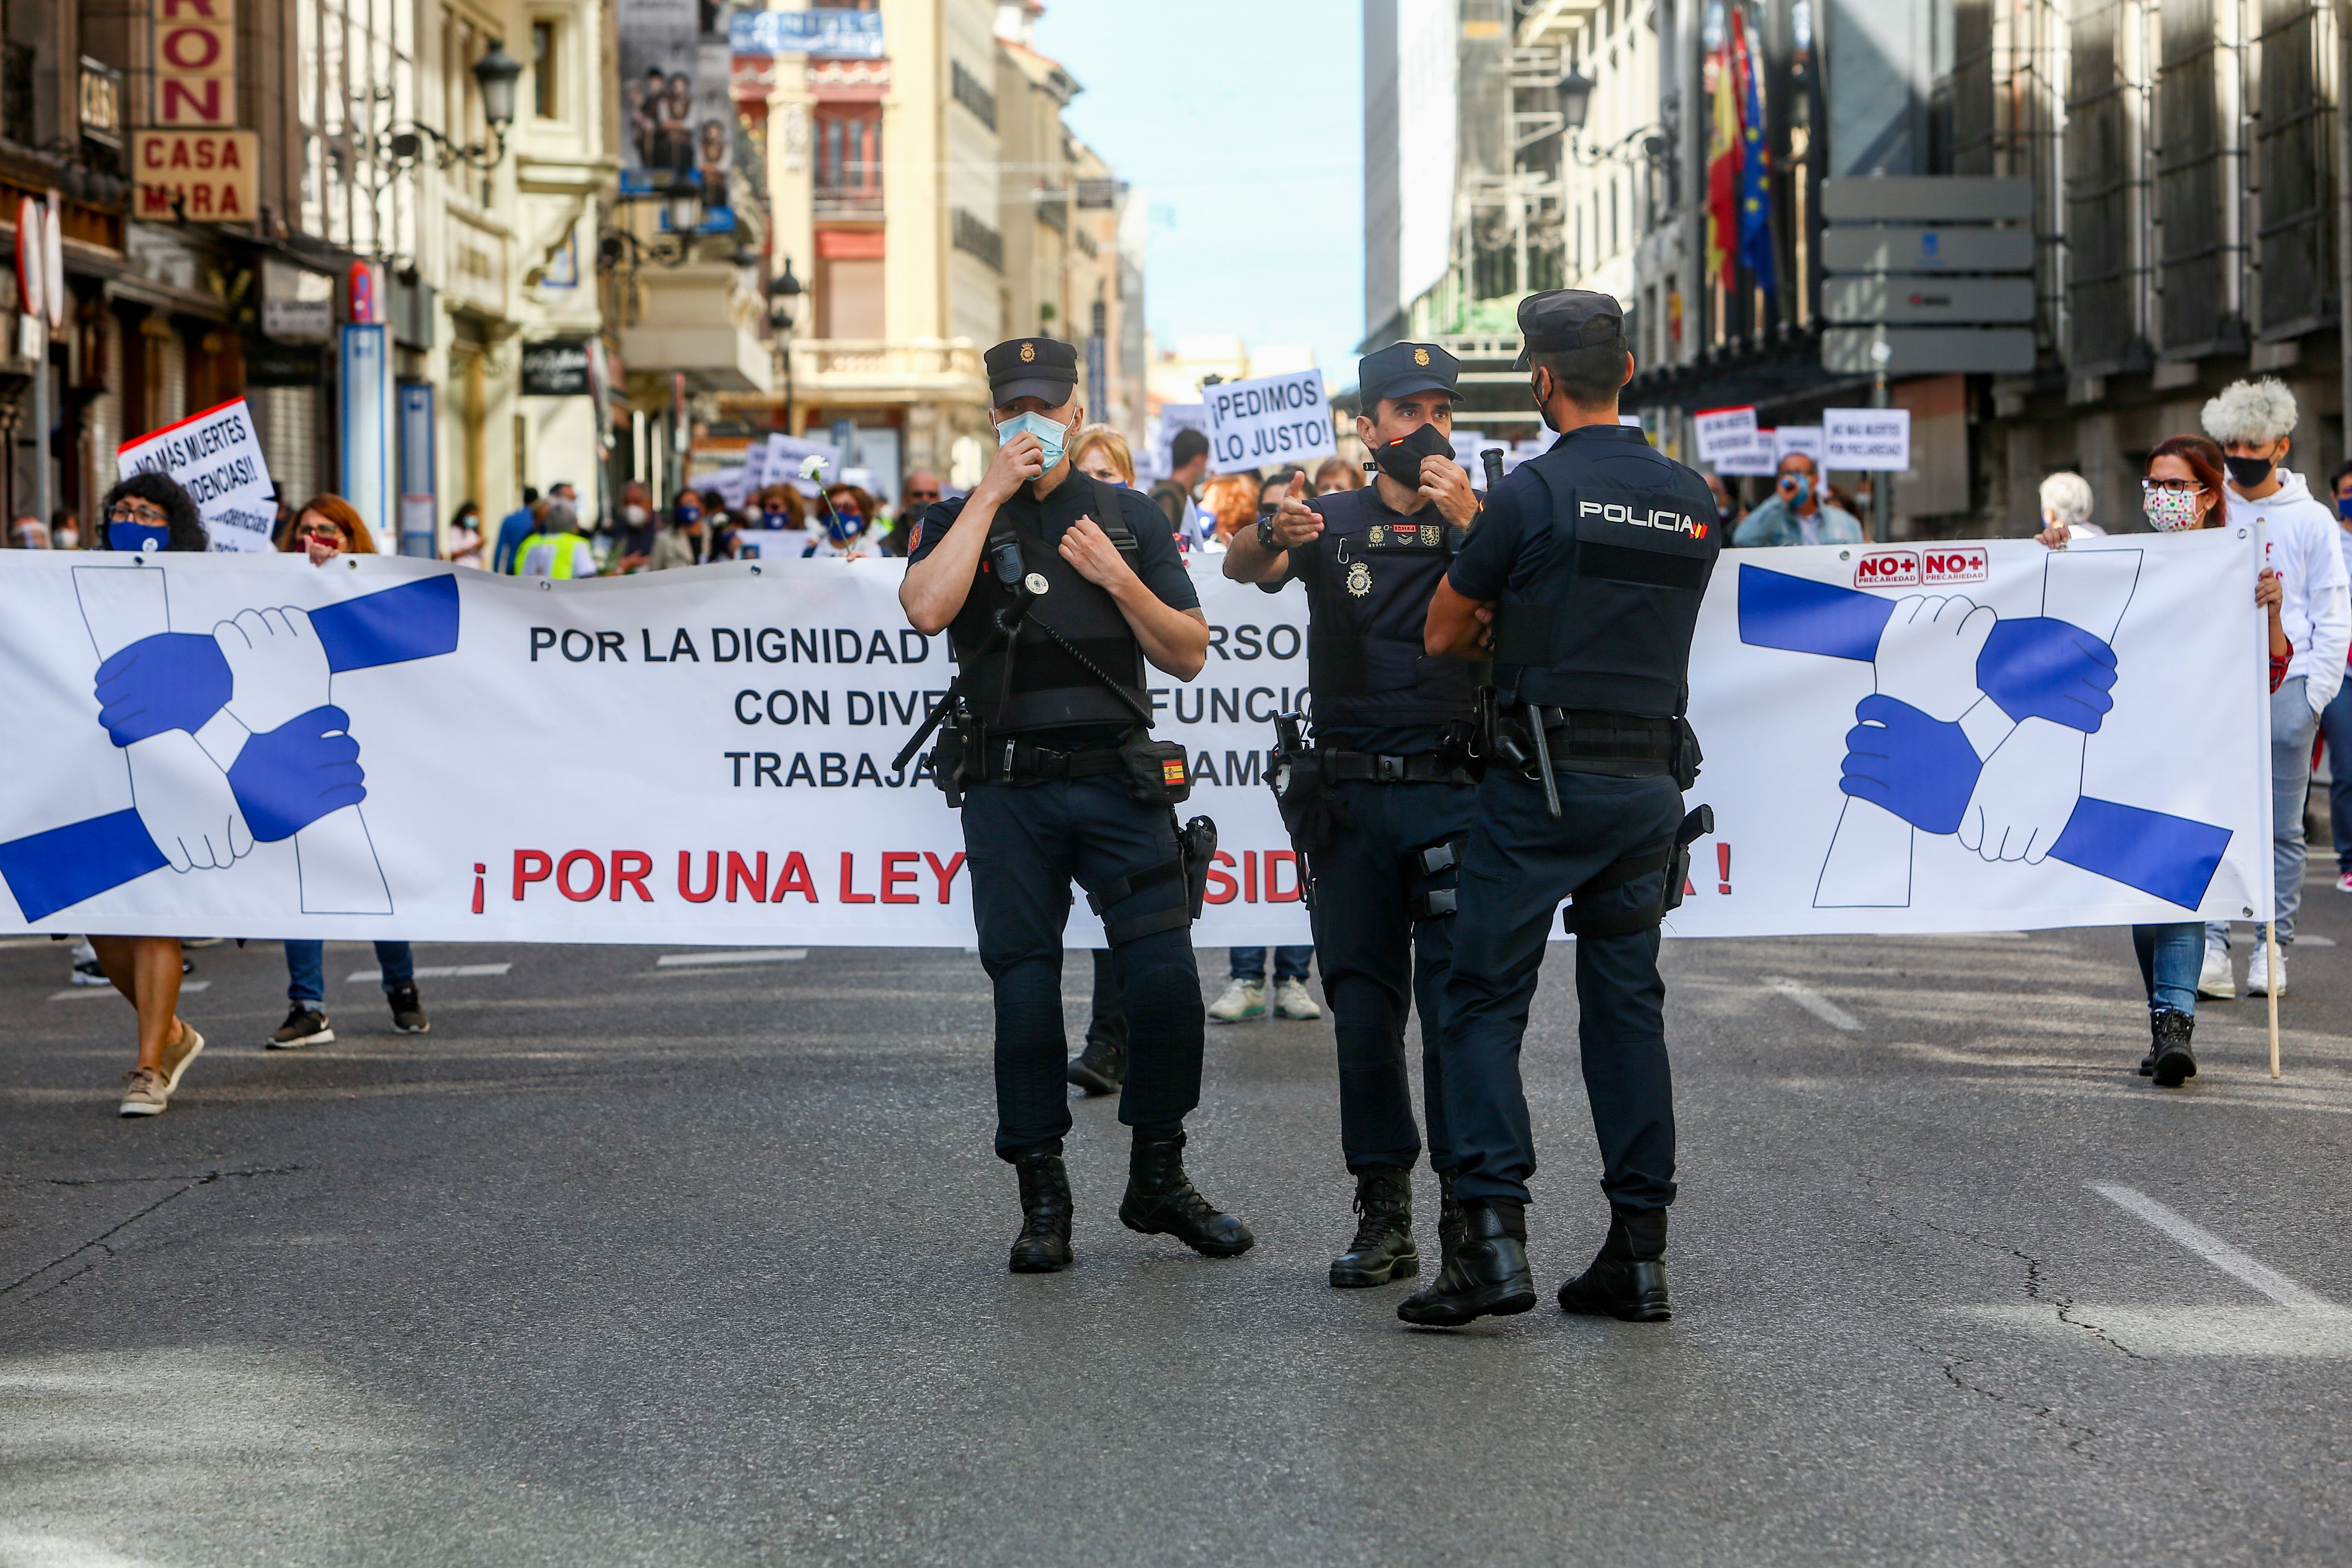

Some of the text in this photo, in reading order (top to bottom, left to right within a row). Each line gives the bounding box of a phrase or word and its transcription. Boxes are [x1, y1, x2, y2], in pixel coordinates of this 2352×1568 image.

[144, 138, 241, 170] CASA
[1211, 380, 1318, 430] ¡PEDIMOS
[184, 415, 246, 462] MUERTES
[1215, 418, 1329, 462] LO JUSTO!
[1580, 501, 1695, 534] POLICIA
[1859, 557, 1915, 577] NO+
[1859, 575, 1915, 583] PRECARIEDAD
[1926, 555, 1983, 573] NO+
[530, 627, 627, 662] POR
[642, 628, 699, 663] LA
[713, 628, 929, 664] DIGNIDAD
[1206, 624, 1309, 661] RSO
[734, 689, 829, 725] CON
[847, 690, 949, 725] DIVE
[724, 752, 938, 788] TRABAJA
[513, 849, 653, 902] POR
[678, 851, 818, 904] UNA
[839, 852, 966, 905] LEY
